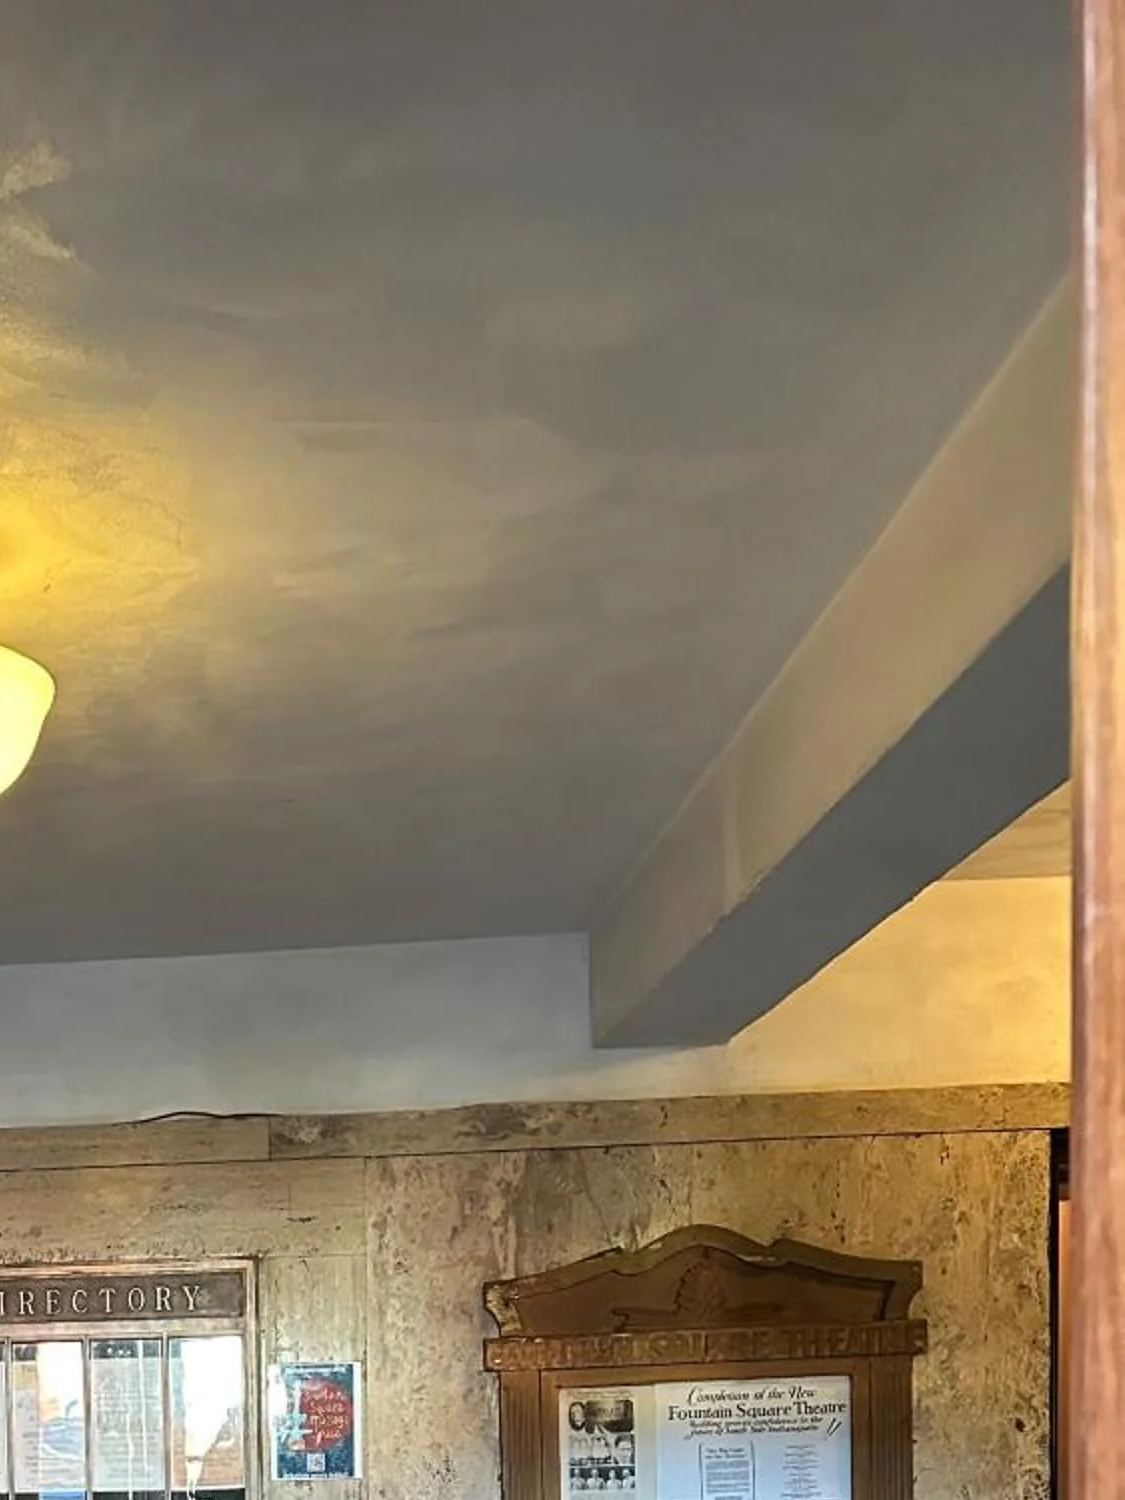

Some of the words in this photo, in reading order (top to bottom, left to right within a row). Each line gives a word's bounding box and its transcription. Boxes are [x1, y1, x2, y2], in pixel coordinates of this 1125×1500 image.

[788, 1386, 816, 1399] New
[668, 1405, 732, 1420] Fountain
[736, 1403, 791, 1418] Square
[793, 1401, 847, 1415] Theatre
